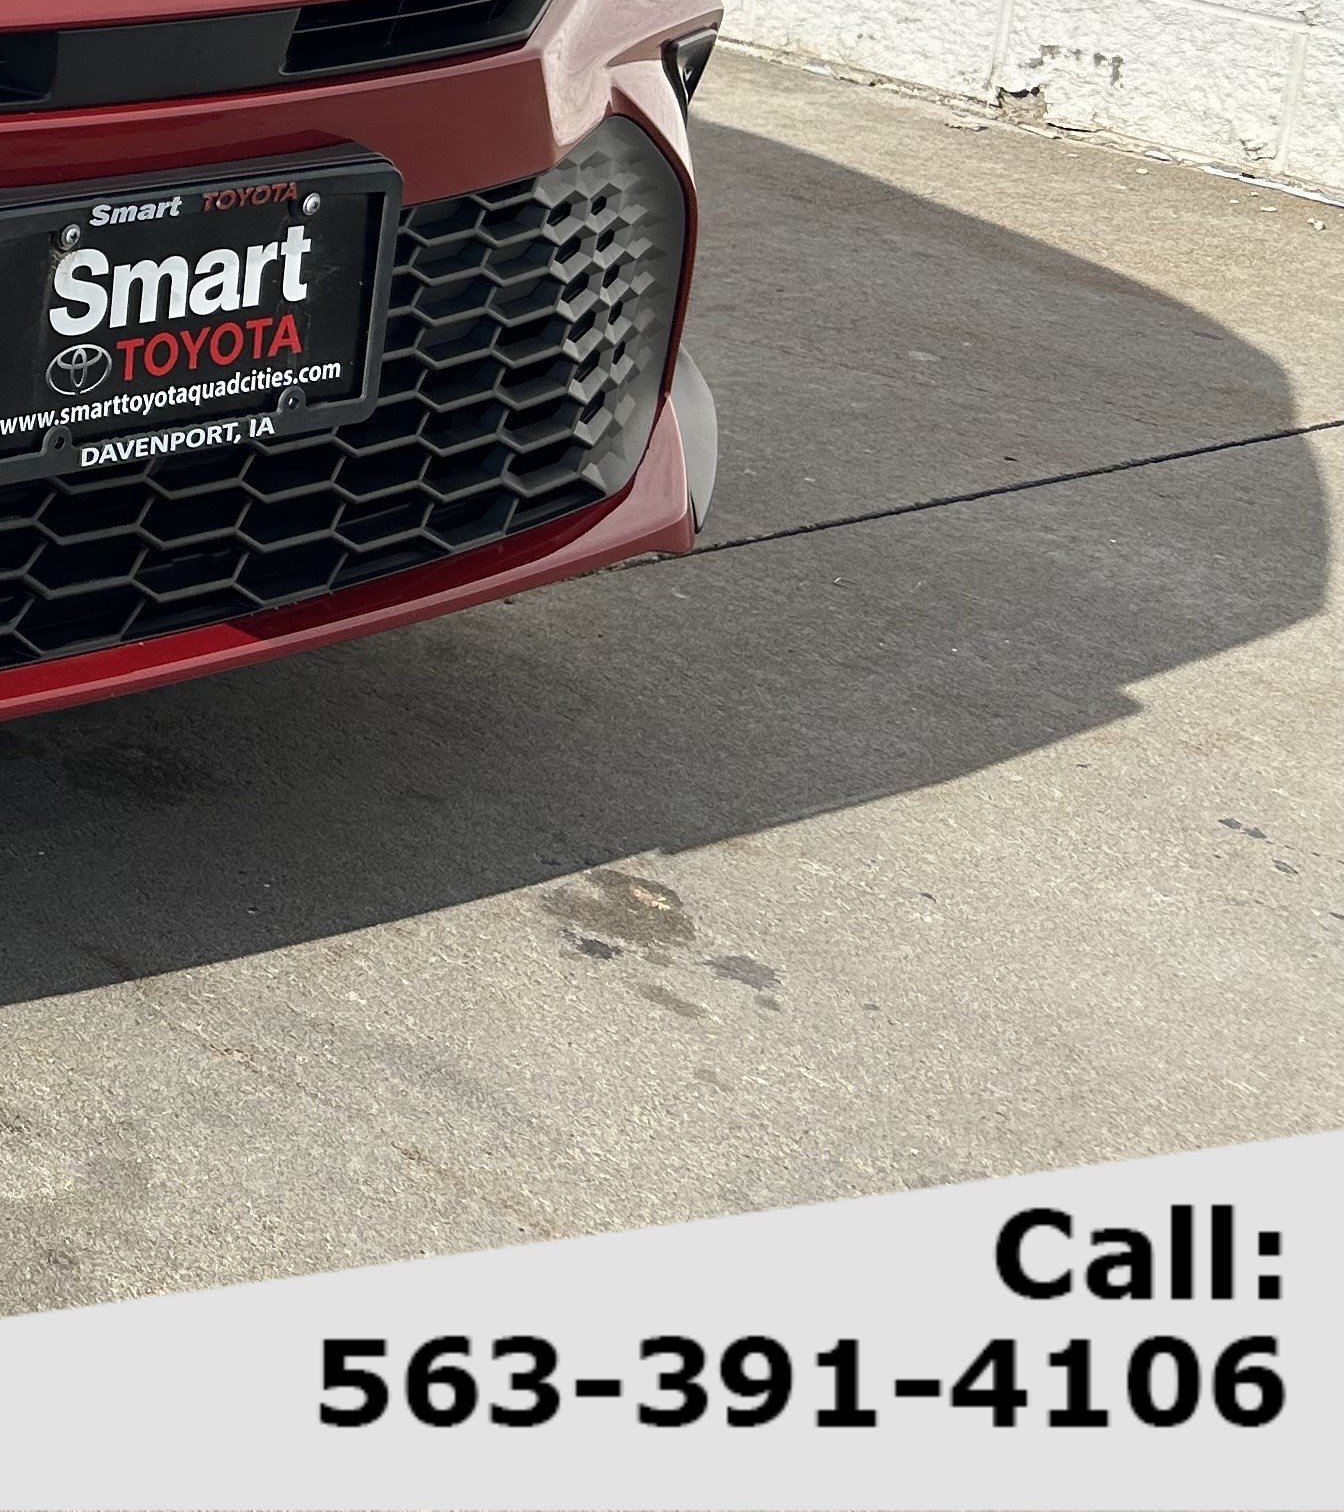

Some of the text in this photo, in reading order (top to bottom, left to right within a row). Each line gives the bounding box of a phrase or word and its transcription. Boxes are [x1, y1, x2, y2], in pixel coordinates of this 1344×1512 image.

[89, 182, 298, 227] Smart TOYOTA
[48, 225, 312, 337] Smart
[116, 314, 302, 381] TOYOTA
[0, 360, 341, 436] www.smarttoyotaquadcities.com
[80, 418, 275, 469] DAVENPORT, IA
